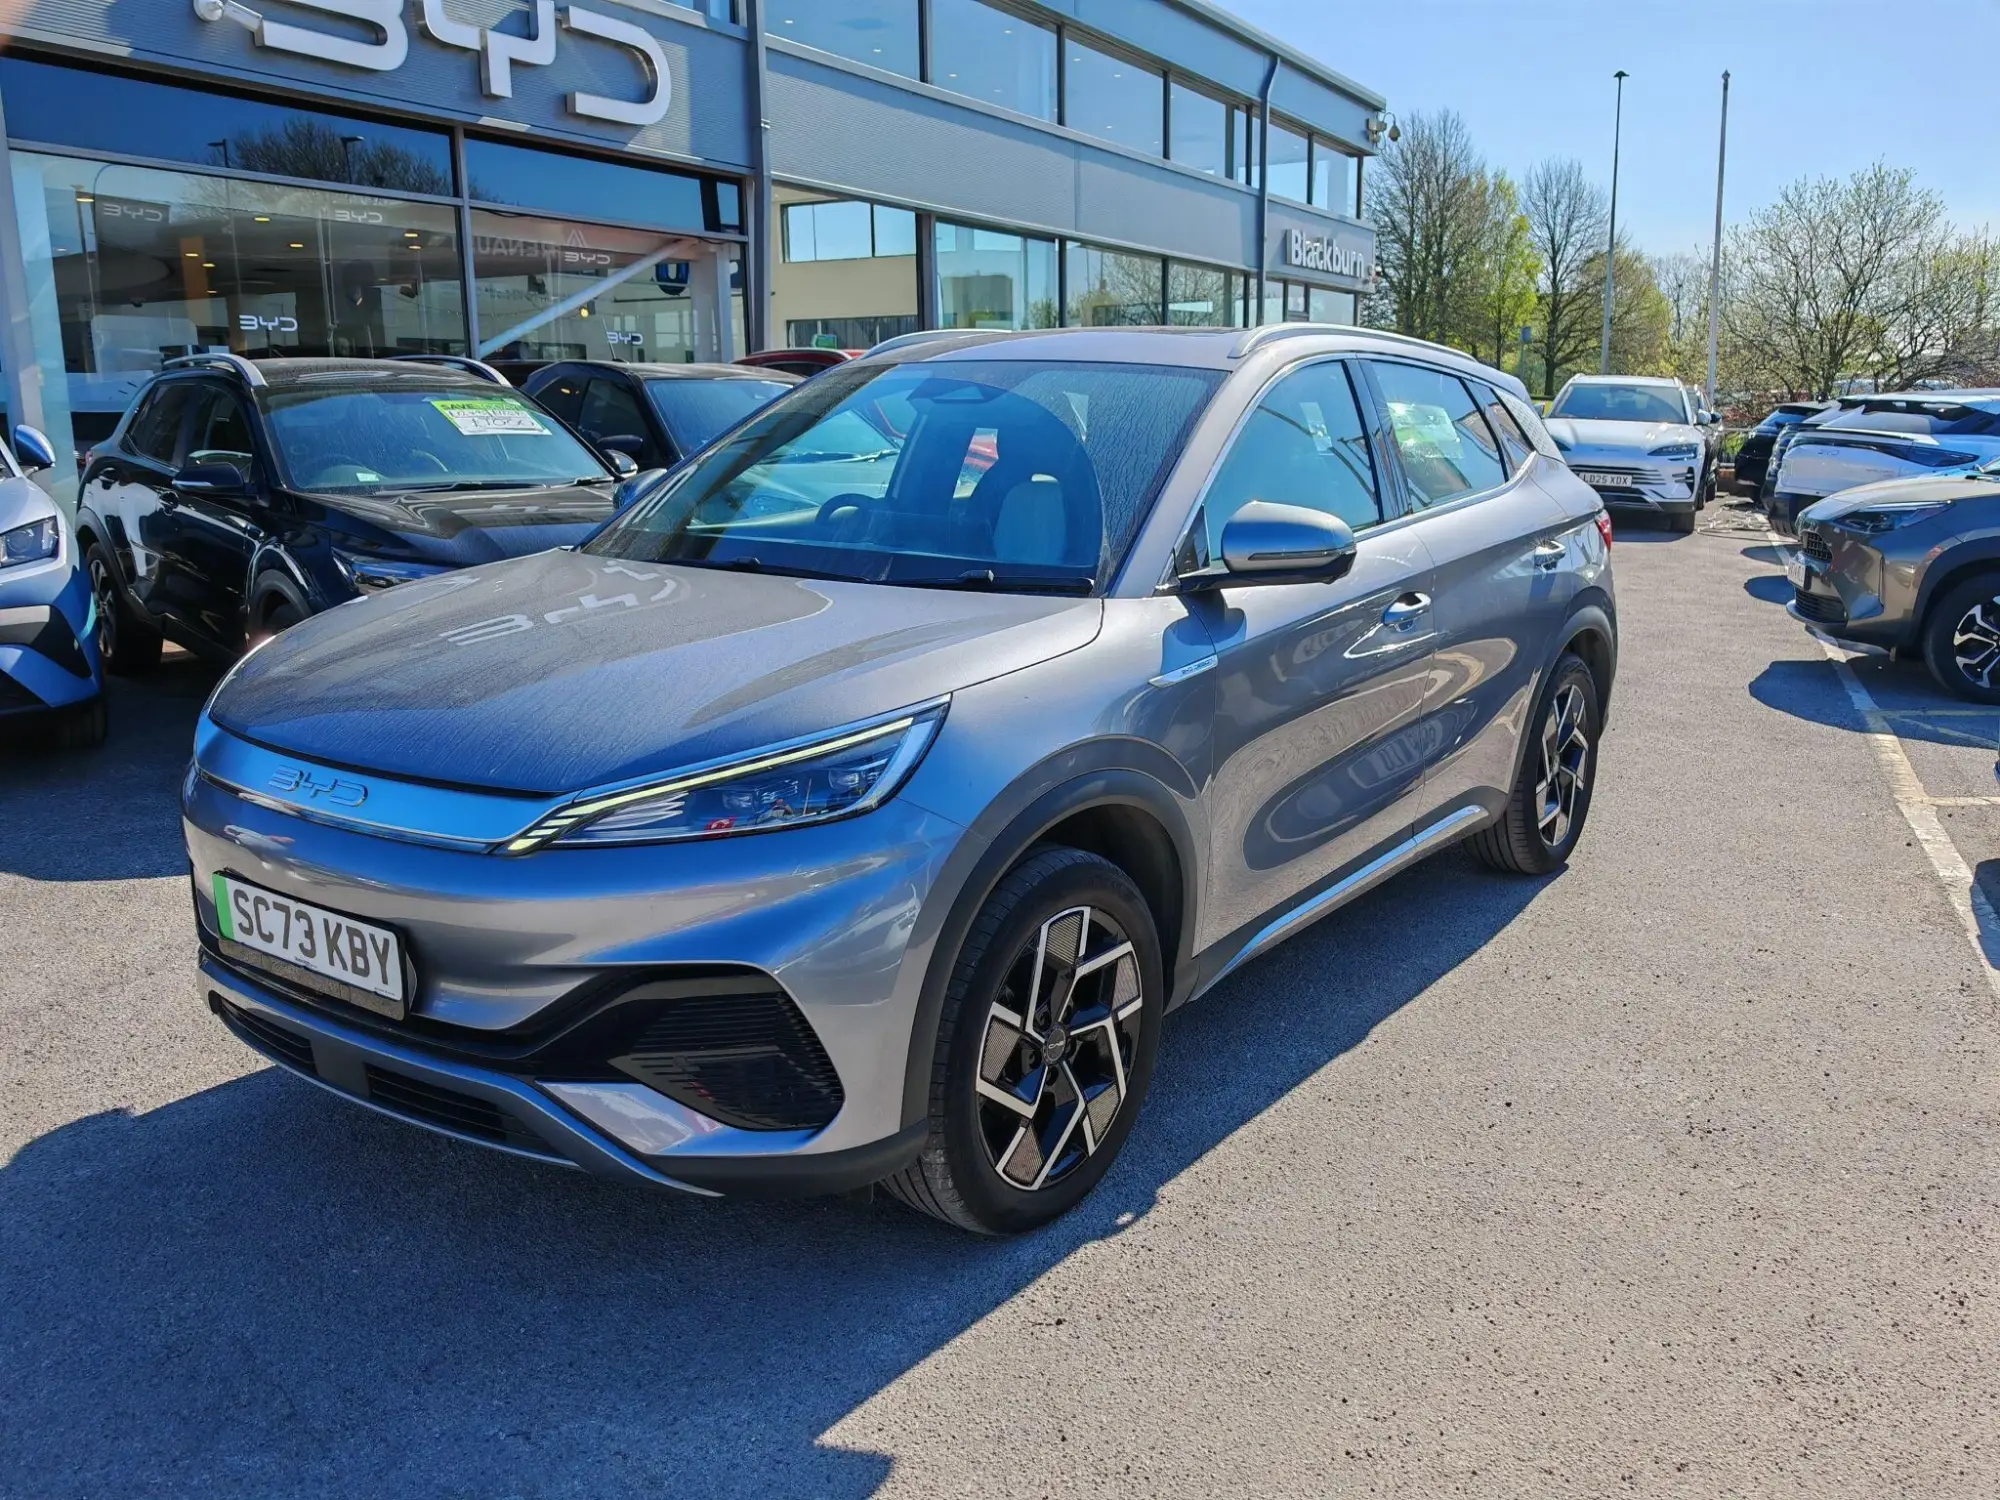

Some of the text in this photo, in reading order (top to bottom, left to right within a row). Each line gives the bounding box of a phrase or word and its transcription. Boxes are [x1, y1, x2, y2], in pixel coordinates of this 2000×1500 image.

[103, 203, 163, 222] BYD
[334, 209, 383, 223] BYD
[564, 251, 611, 265] BYD
[1288, 229, 1365, 278] Blackburn
[239, 314, 298, 332] BYD
[606, 330, 644, 345] BYD
[268, 764, 369, 808] BYD
[233, 888, 391, 985] SC73 KBY
